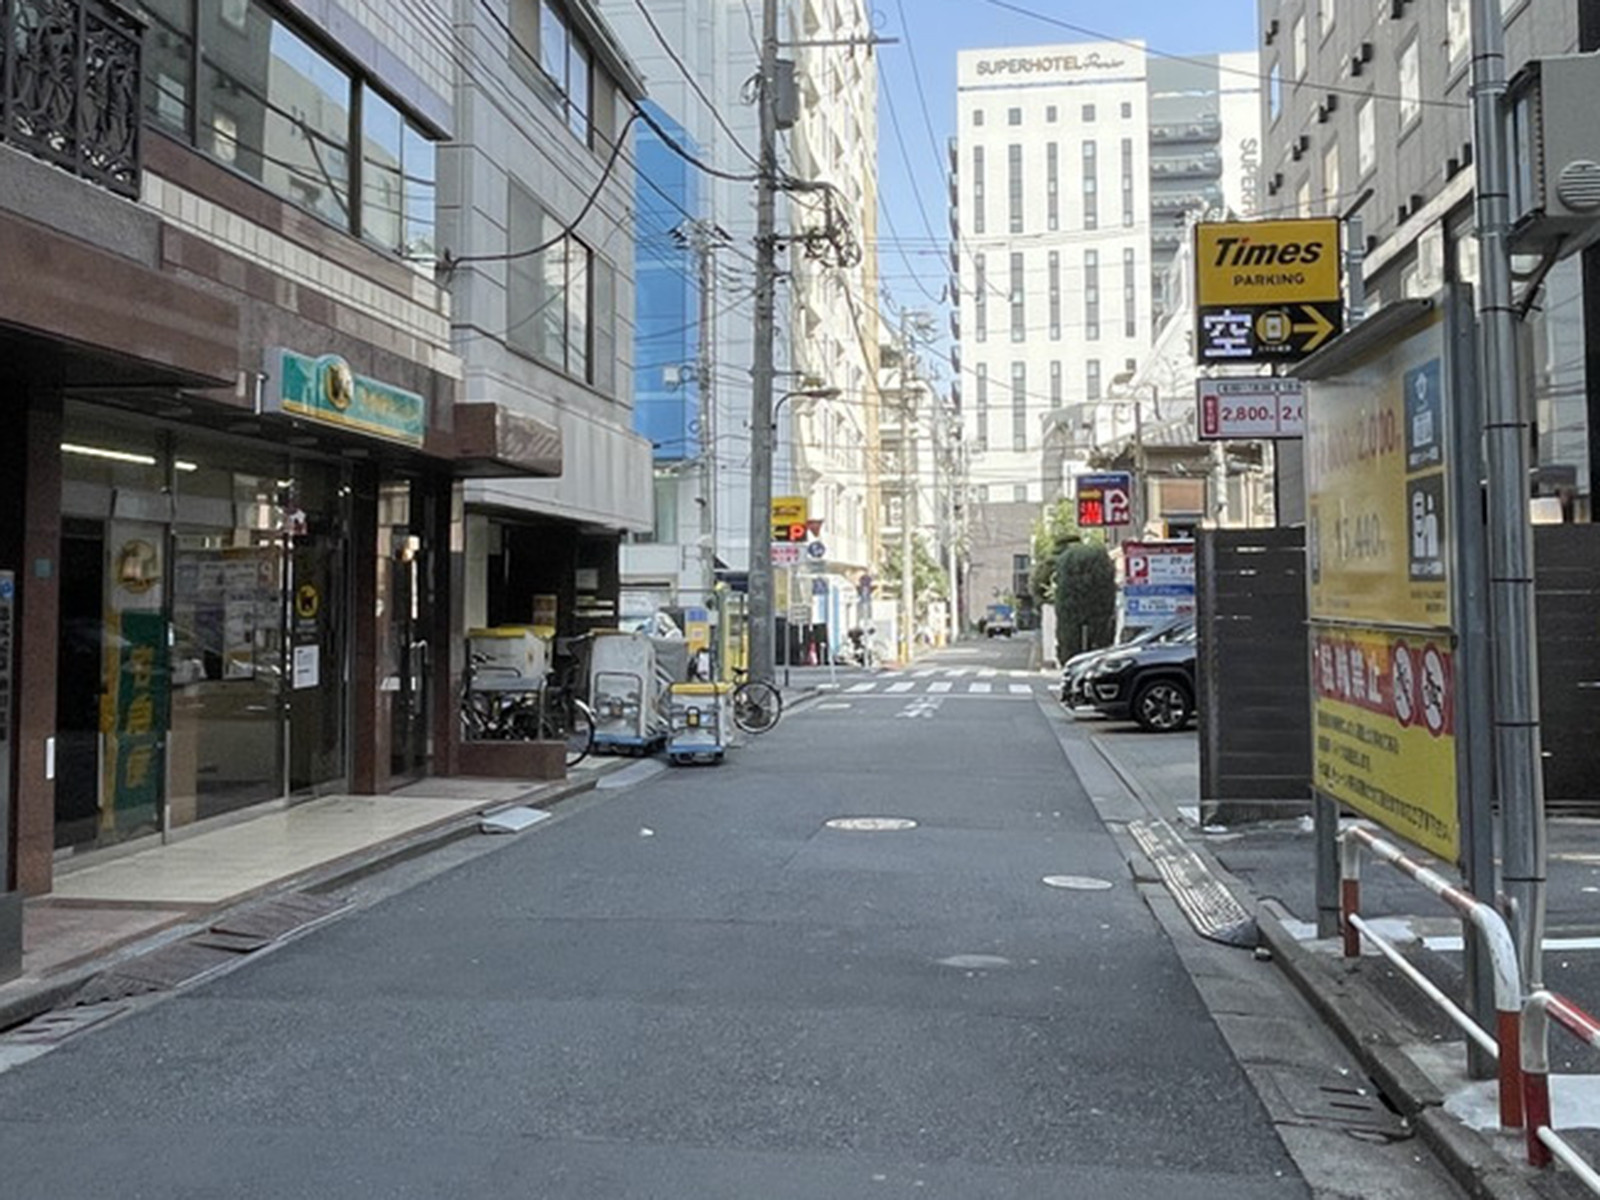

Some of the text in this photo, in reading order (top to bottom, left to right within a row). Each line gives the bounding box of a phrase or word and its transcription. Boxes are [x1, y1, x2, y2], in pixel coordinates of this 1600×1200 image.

[977, 55, 1082, 75] SUPERHOTEL
[1215, 237, 1322, 266] Times
[1234, 273, 1304, 285] PARKING
[1204, 309, 1252, 356] 空
